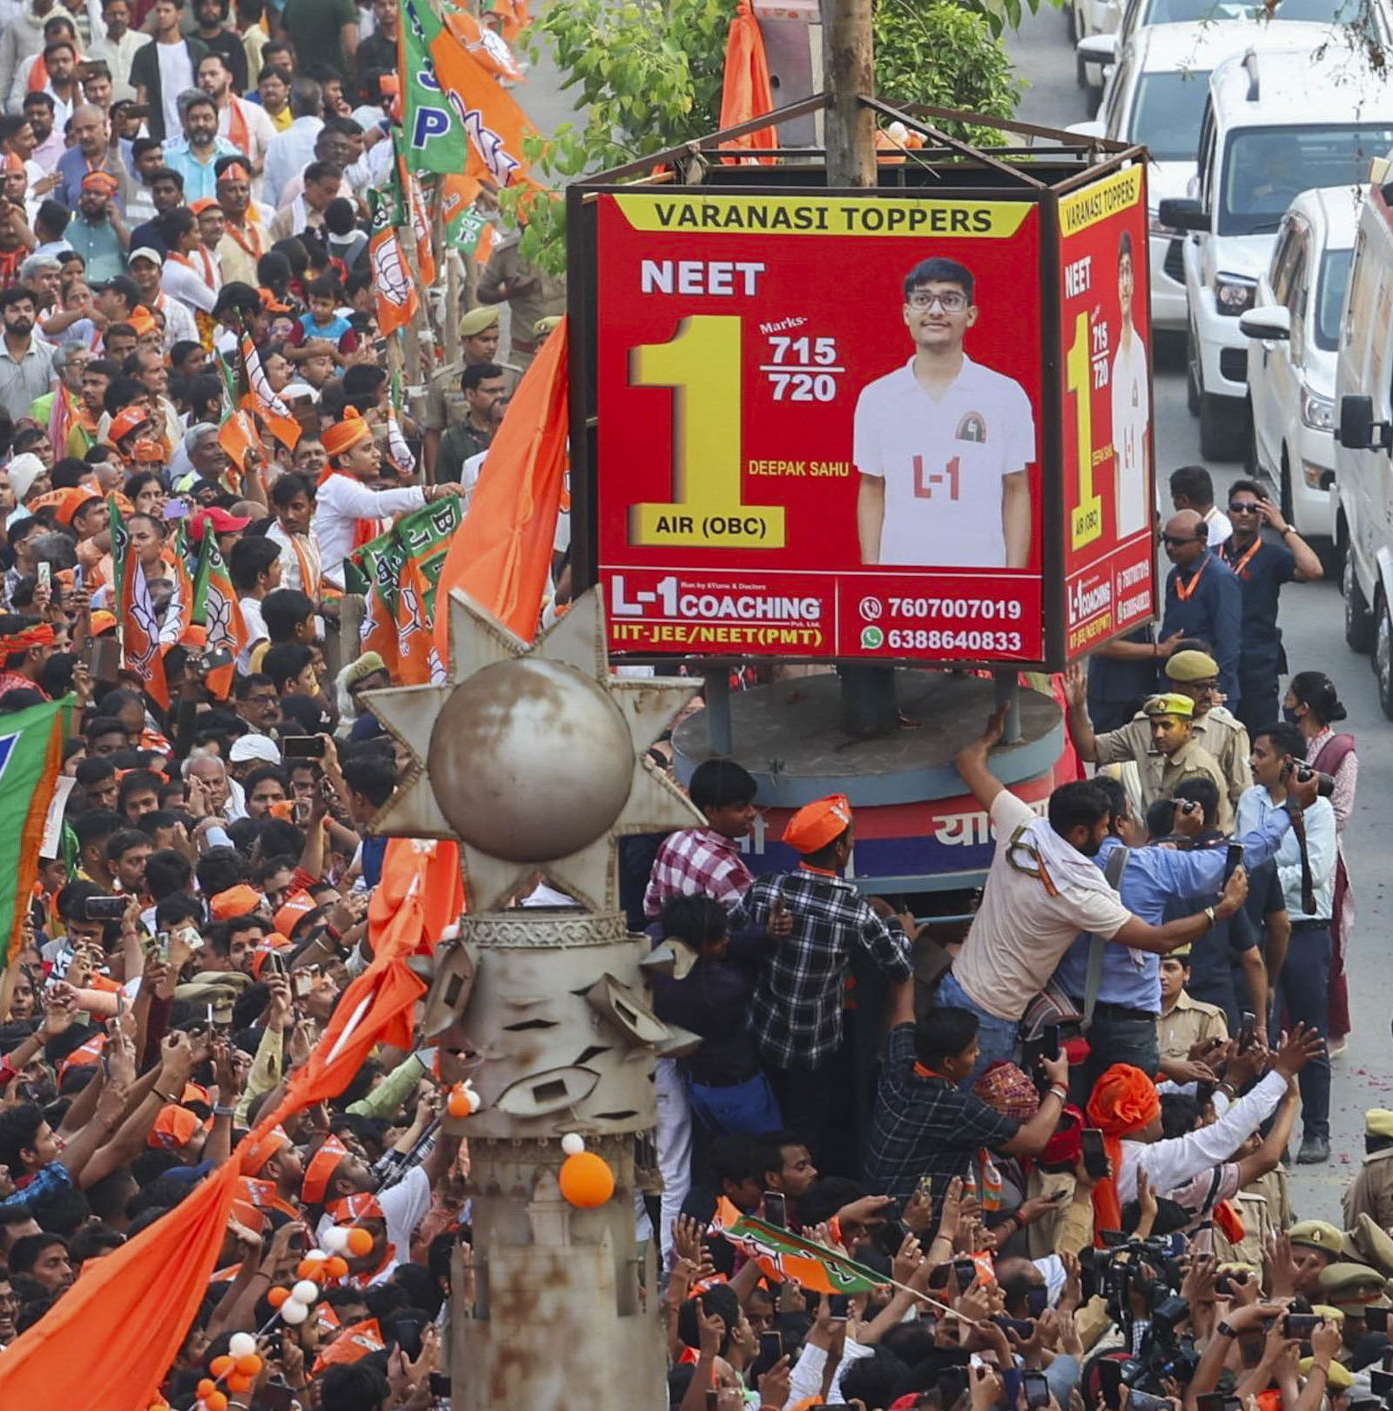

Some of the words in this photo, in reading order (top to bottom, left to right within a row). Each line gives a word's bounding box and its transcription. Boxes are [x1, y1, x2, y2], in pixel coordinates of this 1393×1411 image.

[655, 203, 829, 231] VARANASI
[841, 205, 993, 233] TOPPERS
[1066, 201, 1102, 231] VARANASI
[1103, 178, 1135, 211] TOPPERS
[640, 259, 766, 297] NEET
[1064, 256, 1092, 300] NEET
[767, 336, 837, 365] 715
[1092, 321, 1108, 354] 715
[767, 373, 837, 402] 720
[1093, 358, 1109, 390] 720
[628, 314, 785, 549] 1
[1067, 310, 1104, 554] 1
[748, 460, 807, 477] DEEPAK
[809, 461, 850, 478] SAHU
[912, 454, 961, 501] L-1
[655, 515, 694, 536] AIR
[701, 516, 767, 539] (OBC)
[611, 574, 679, 616] L-1
[679, 594, 821, 620] COACHING
[888, 597, 1021, 621] 7607007019
[612, 624, 823, 648] IIT-JEE/NEET(PMT)
[888, 629, 1022, 652] 6388640833
